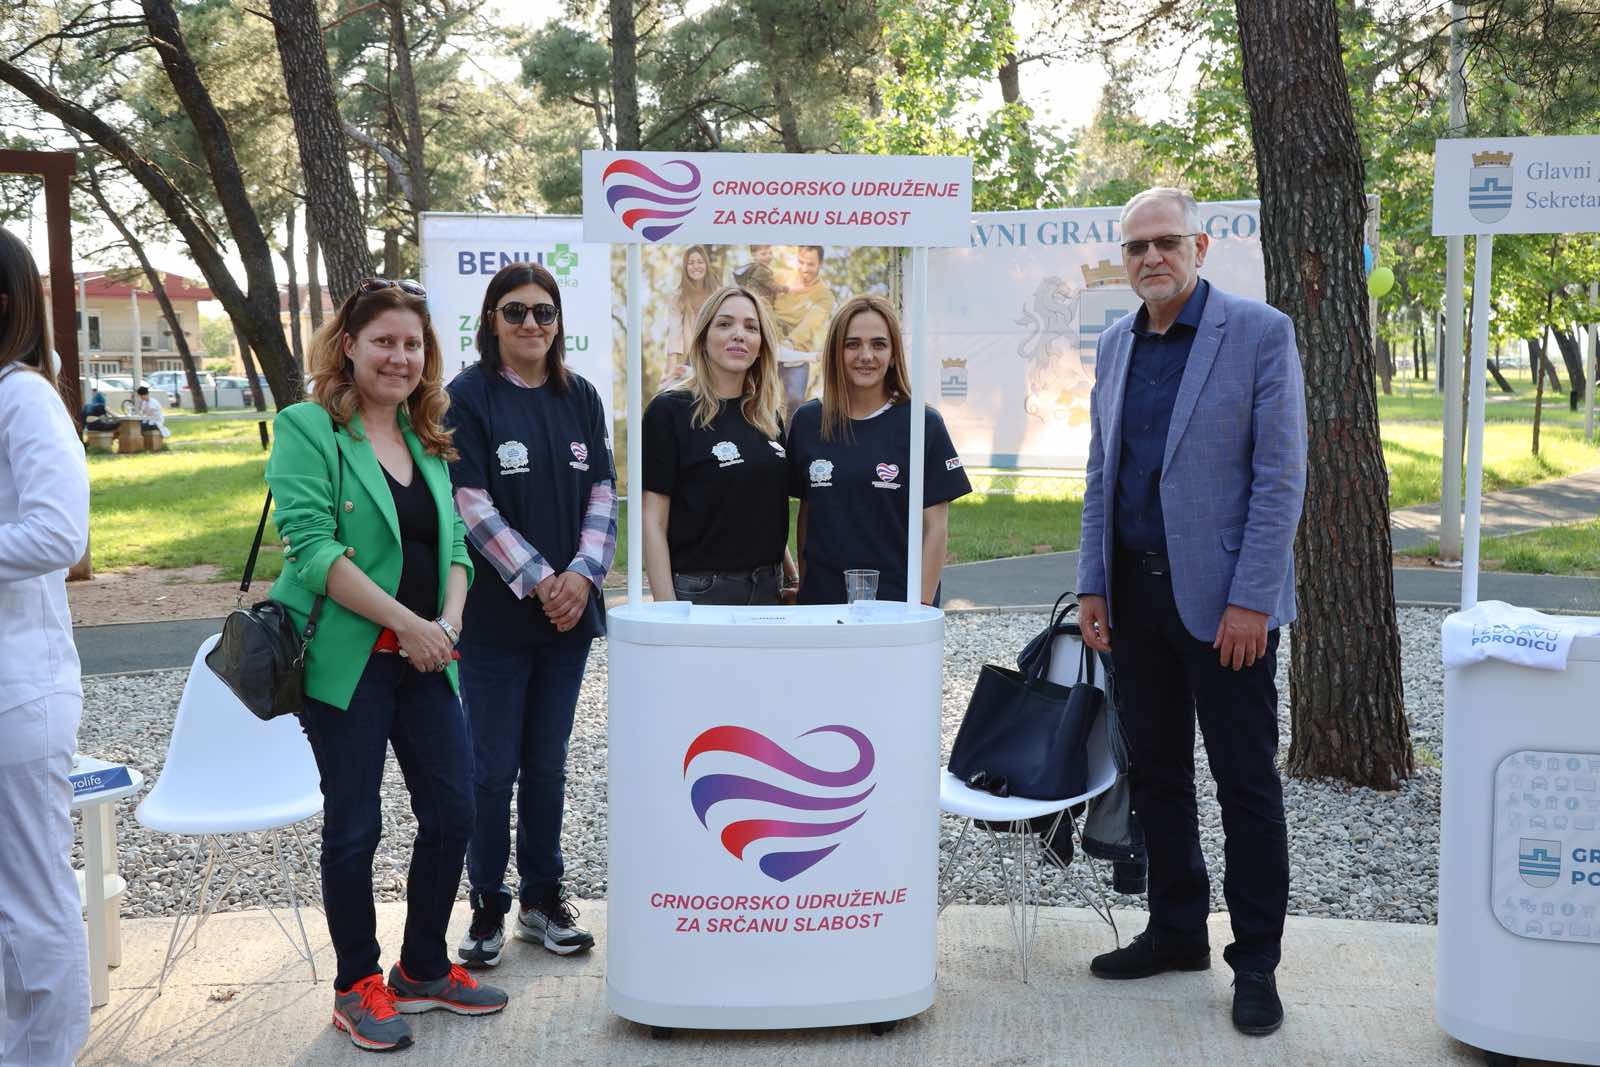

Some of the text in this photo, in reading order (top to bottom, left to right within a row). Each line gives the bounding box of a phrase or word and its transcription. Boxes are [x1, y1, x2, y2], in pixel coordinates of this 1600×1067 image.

[1527, 161, 1592, 180] Glavni
[712, 179, 960, 197] CRNOGORSKO UDRUŽENJE
[713, 207, 911, 226] ZA SRČANU SLABOST
[1471, 634, 1557, 652] PORODICU
[73, 775, 102, 789] rolife
[650, 888, 908, 911] CRNOGORSKO UDRUŽENJE
[676, 912, 884, 933] ZA SRČANU SLABOST
